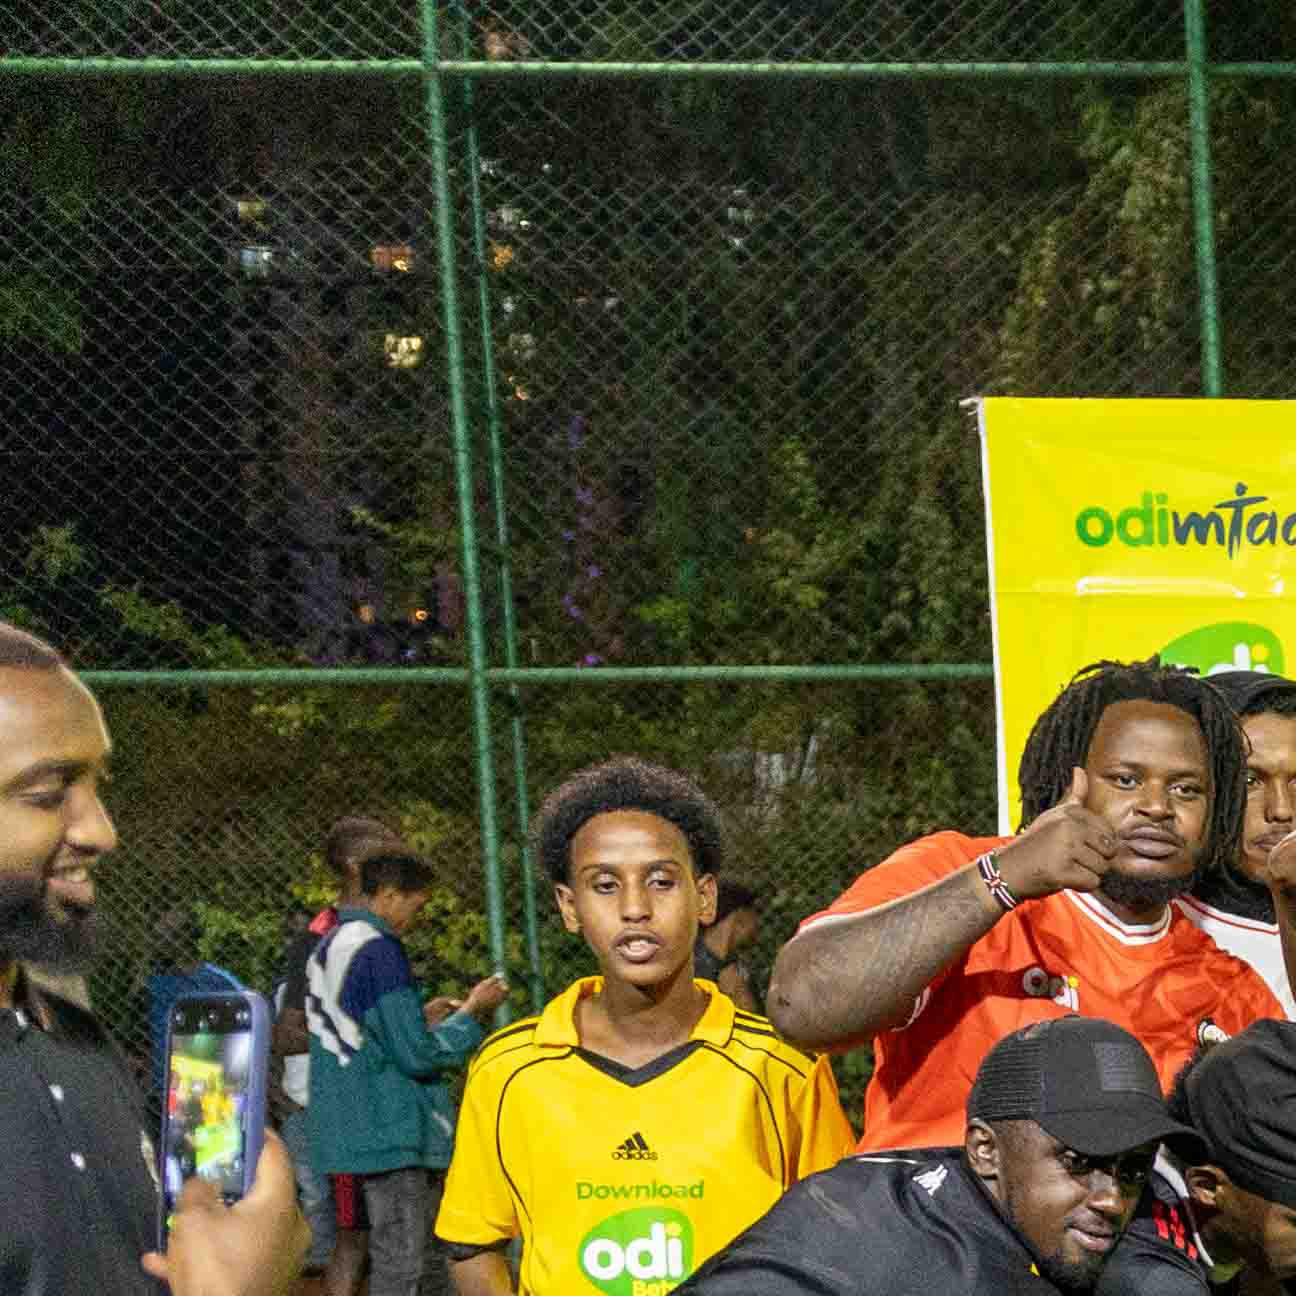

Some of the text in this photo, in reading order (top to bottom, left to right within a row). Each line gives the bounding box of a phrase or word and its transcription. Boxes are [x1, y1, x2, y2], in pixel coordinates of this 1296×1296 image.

[611, 1149, 659, 1162] adidas
[576, 1179, 705, 1200] Download
[583, 1221, 685, 1281] odi
